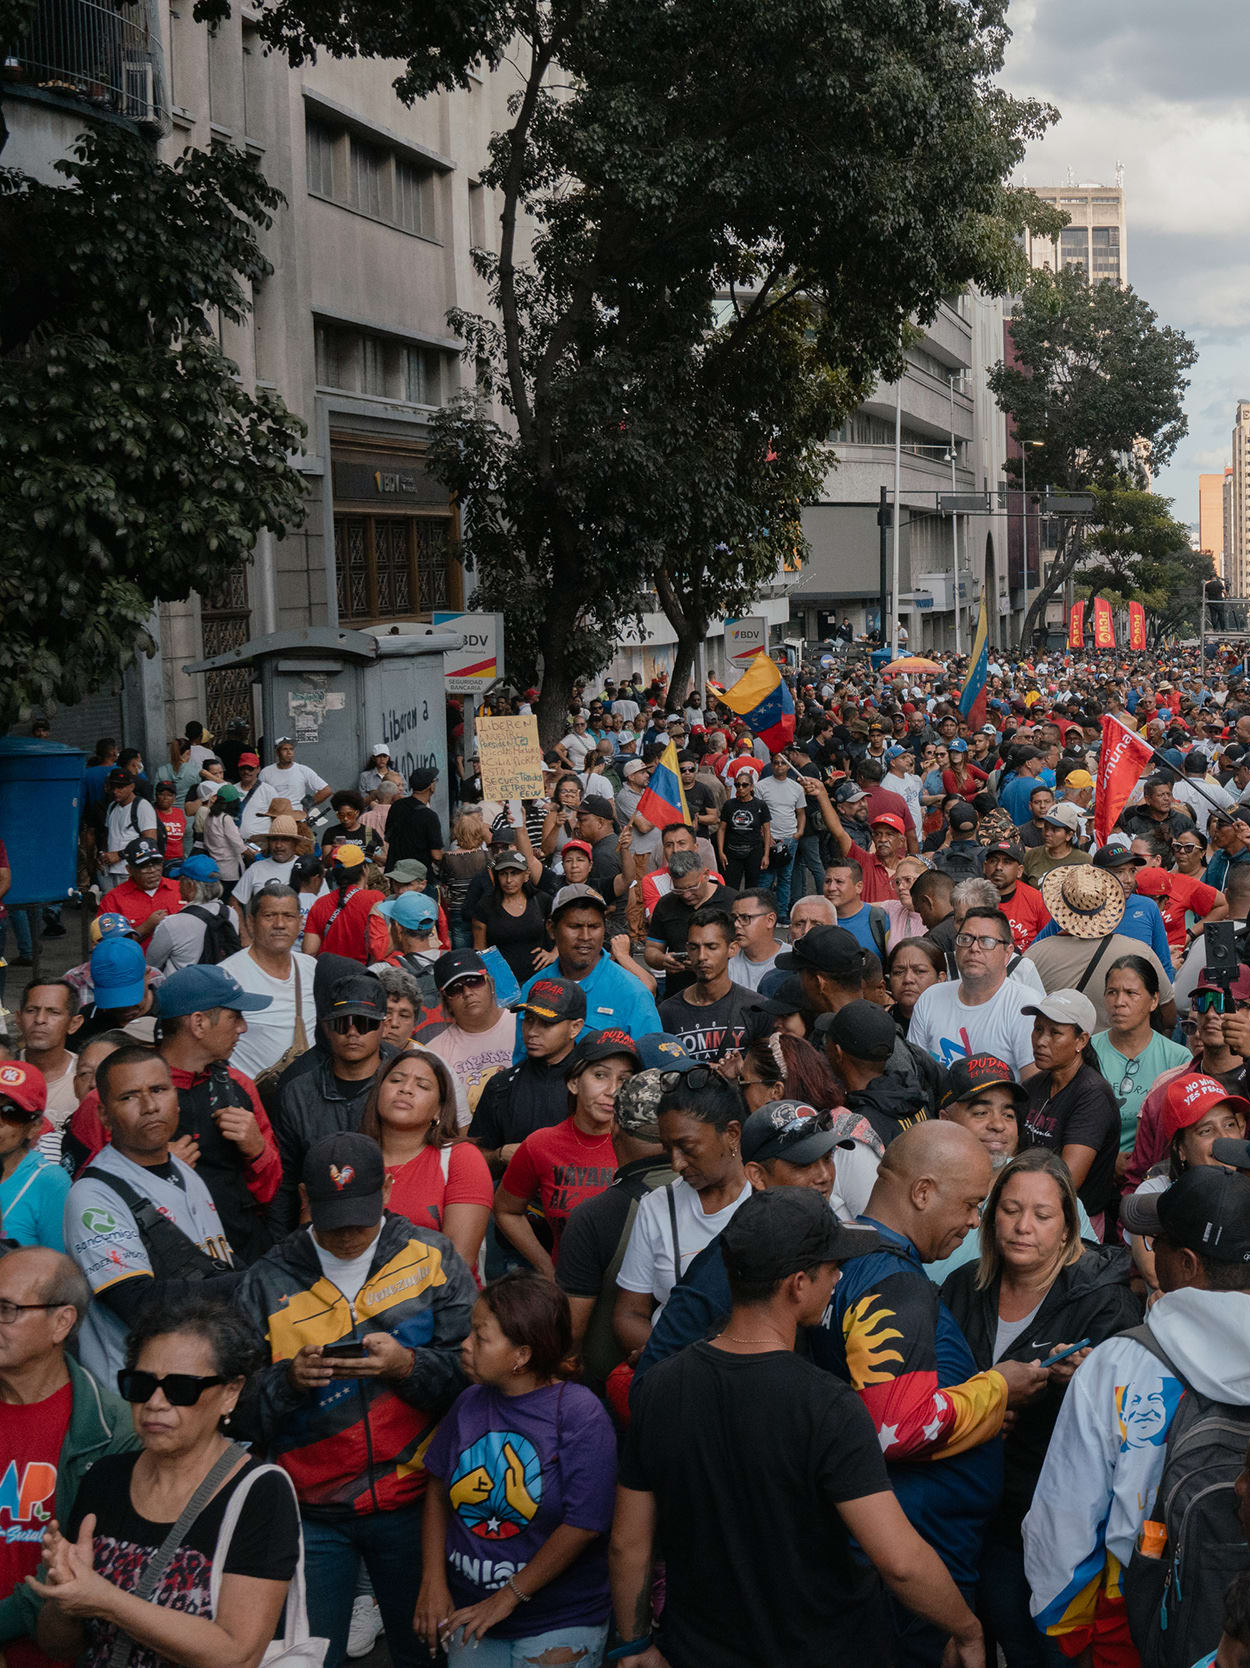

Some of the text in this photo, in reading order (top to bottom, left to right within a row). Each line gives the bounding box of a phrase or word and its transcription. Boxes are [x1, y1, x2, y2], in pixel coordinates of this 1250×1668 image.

[740, 630, 760, 639] BDV
[682, 1030, 745, 1054] OMMY
[1186, 1081, 1199, 1093] NO
[1184, 1091, 1201, 1106] YES
